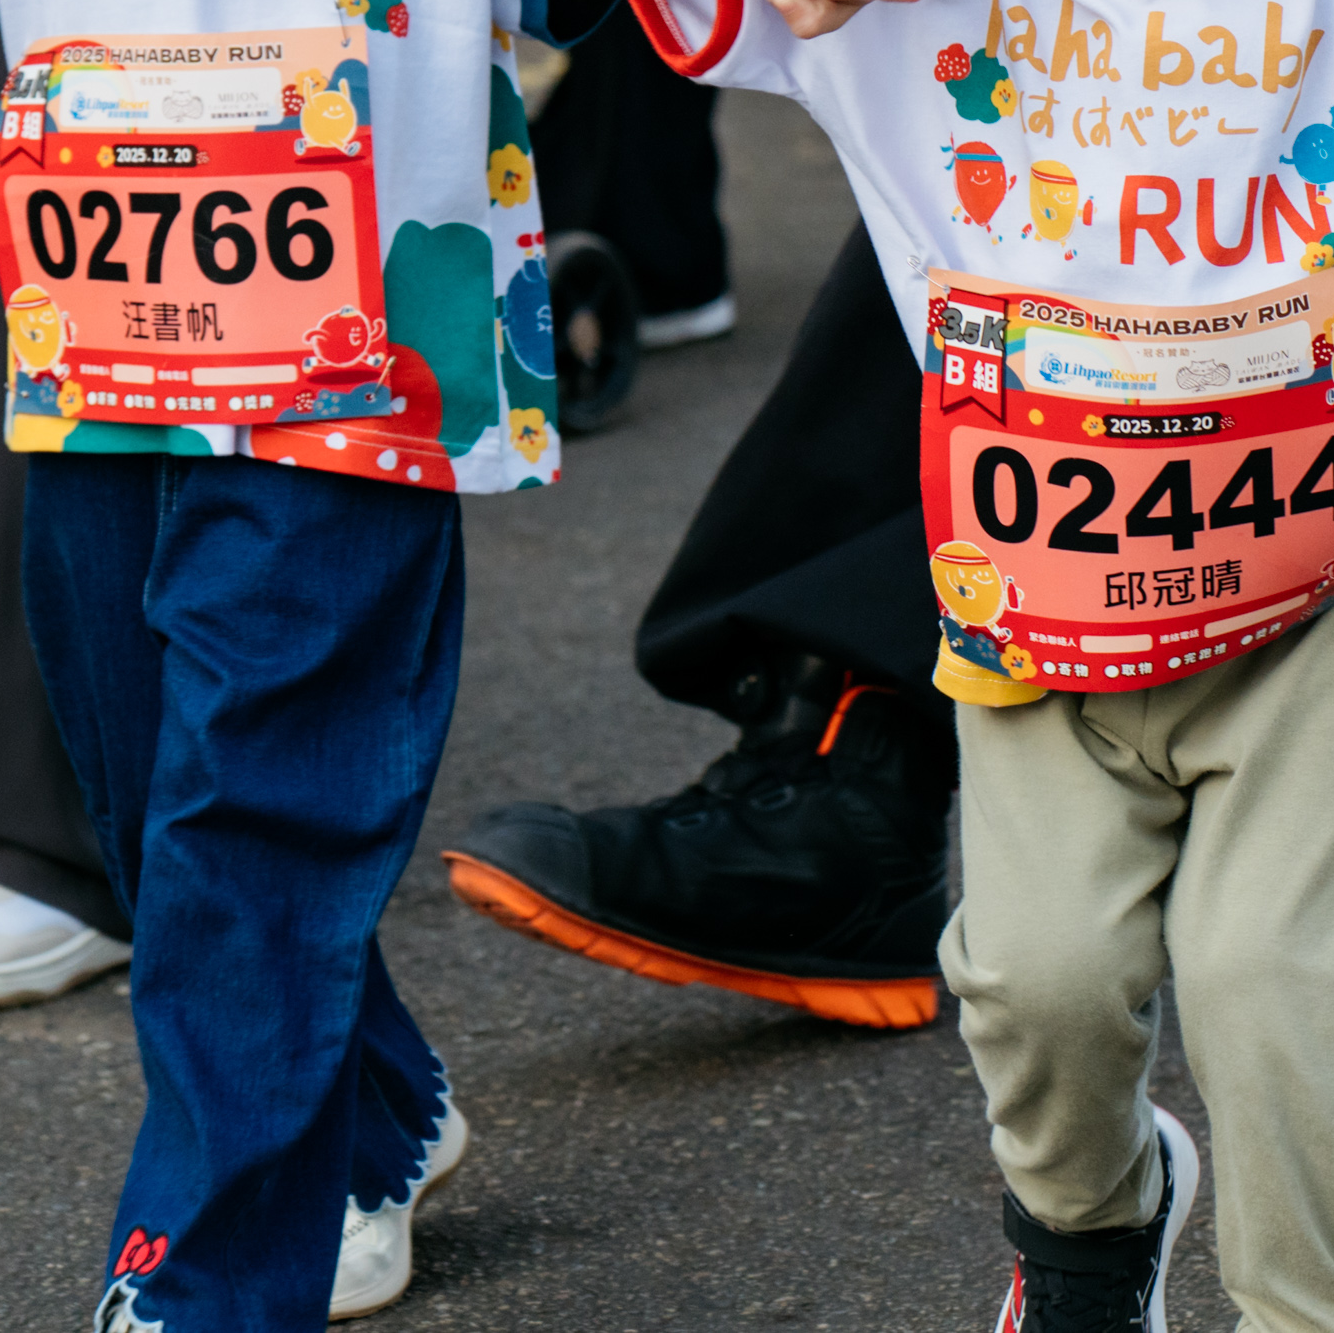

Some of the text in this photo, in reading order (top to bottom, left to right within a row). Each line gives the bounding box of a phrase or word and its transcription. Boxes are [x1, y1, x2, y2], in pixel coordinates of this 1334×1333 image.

[62, 44, 282, 63] 2025 HAHABABY RUN
[116, 147, 192, 163] 2025.12.20
[26, 187, 334, 285] 02766
[1120, 173, 1331, 267] RUN
[122, 300, 224, 342] 汪書帆
[938, 307, 1010, 350] 3.5K
[1020, 294, 1311, 335] 2025 HAHABABY RUN
[1110, 416, 1213, 435] 2025.12.20
[1104, 559, 1243, 610] 邱冠晴
